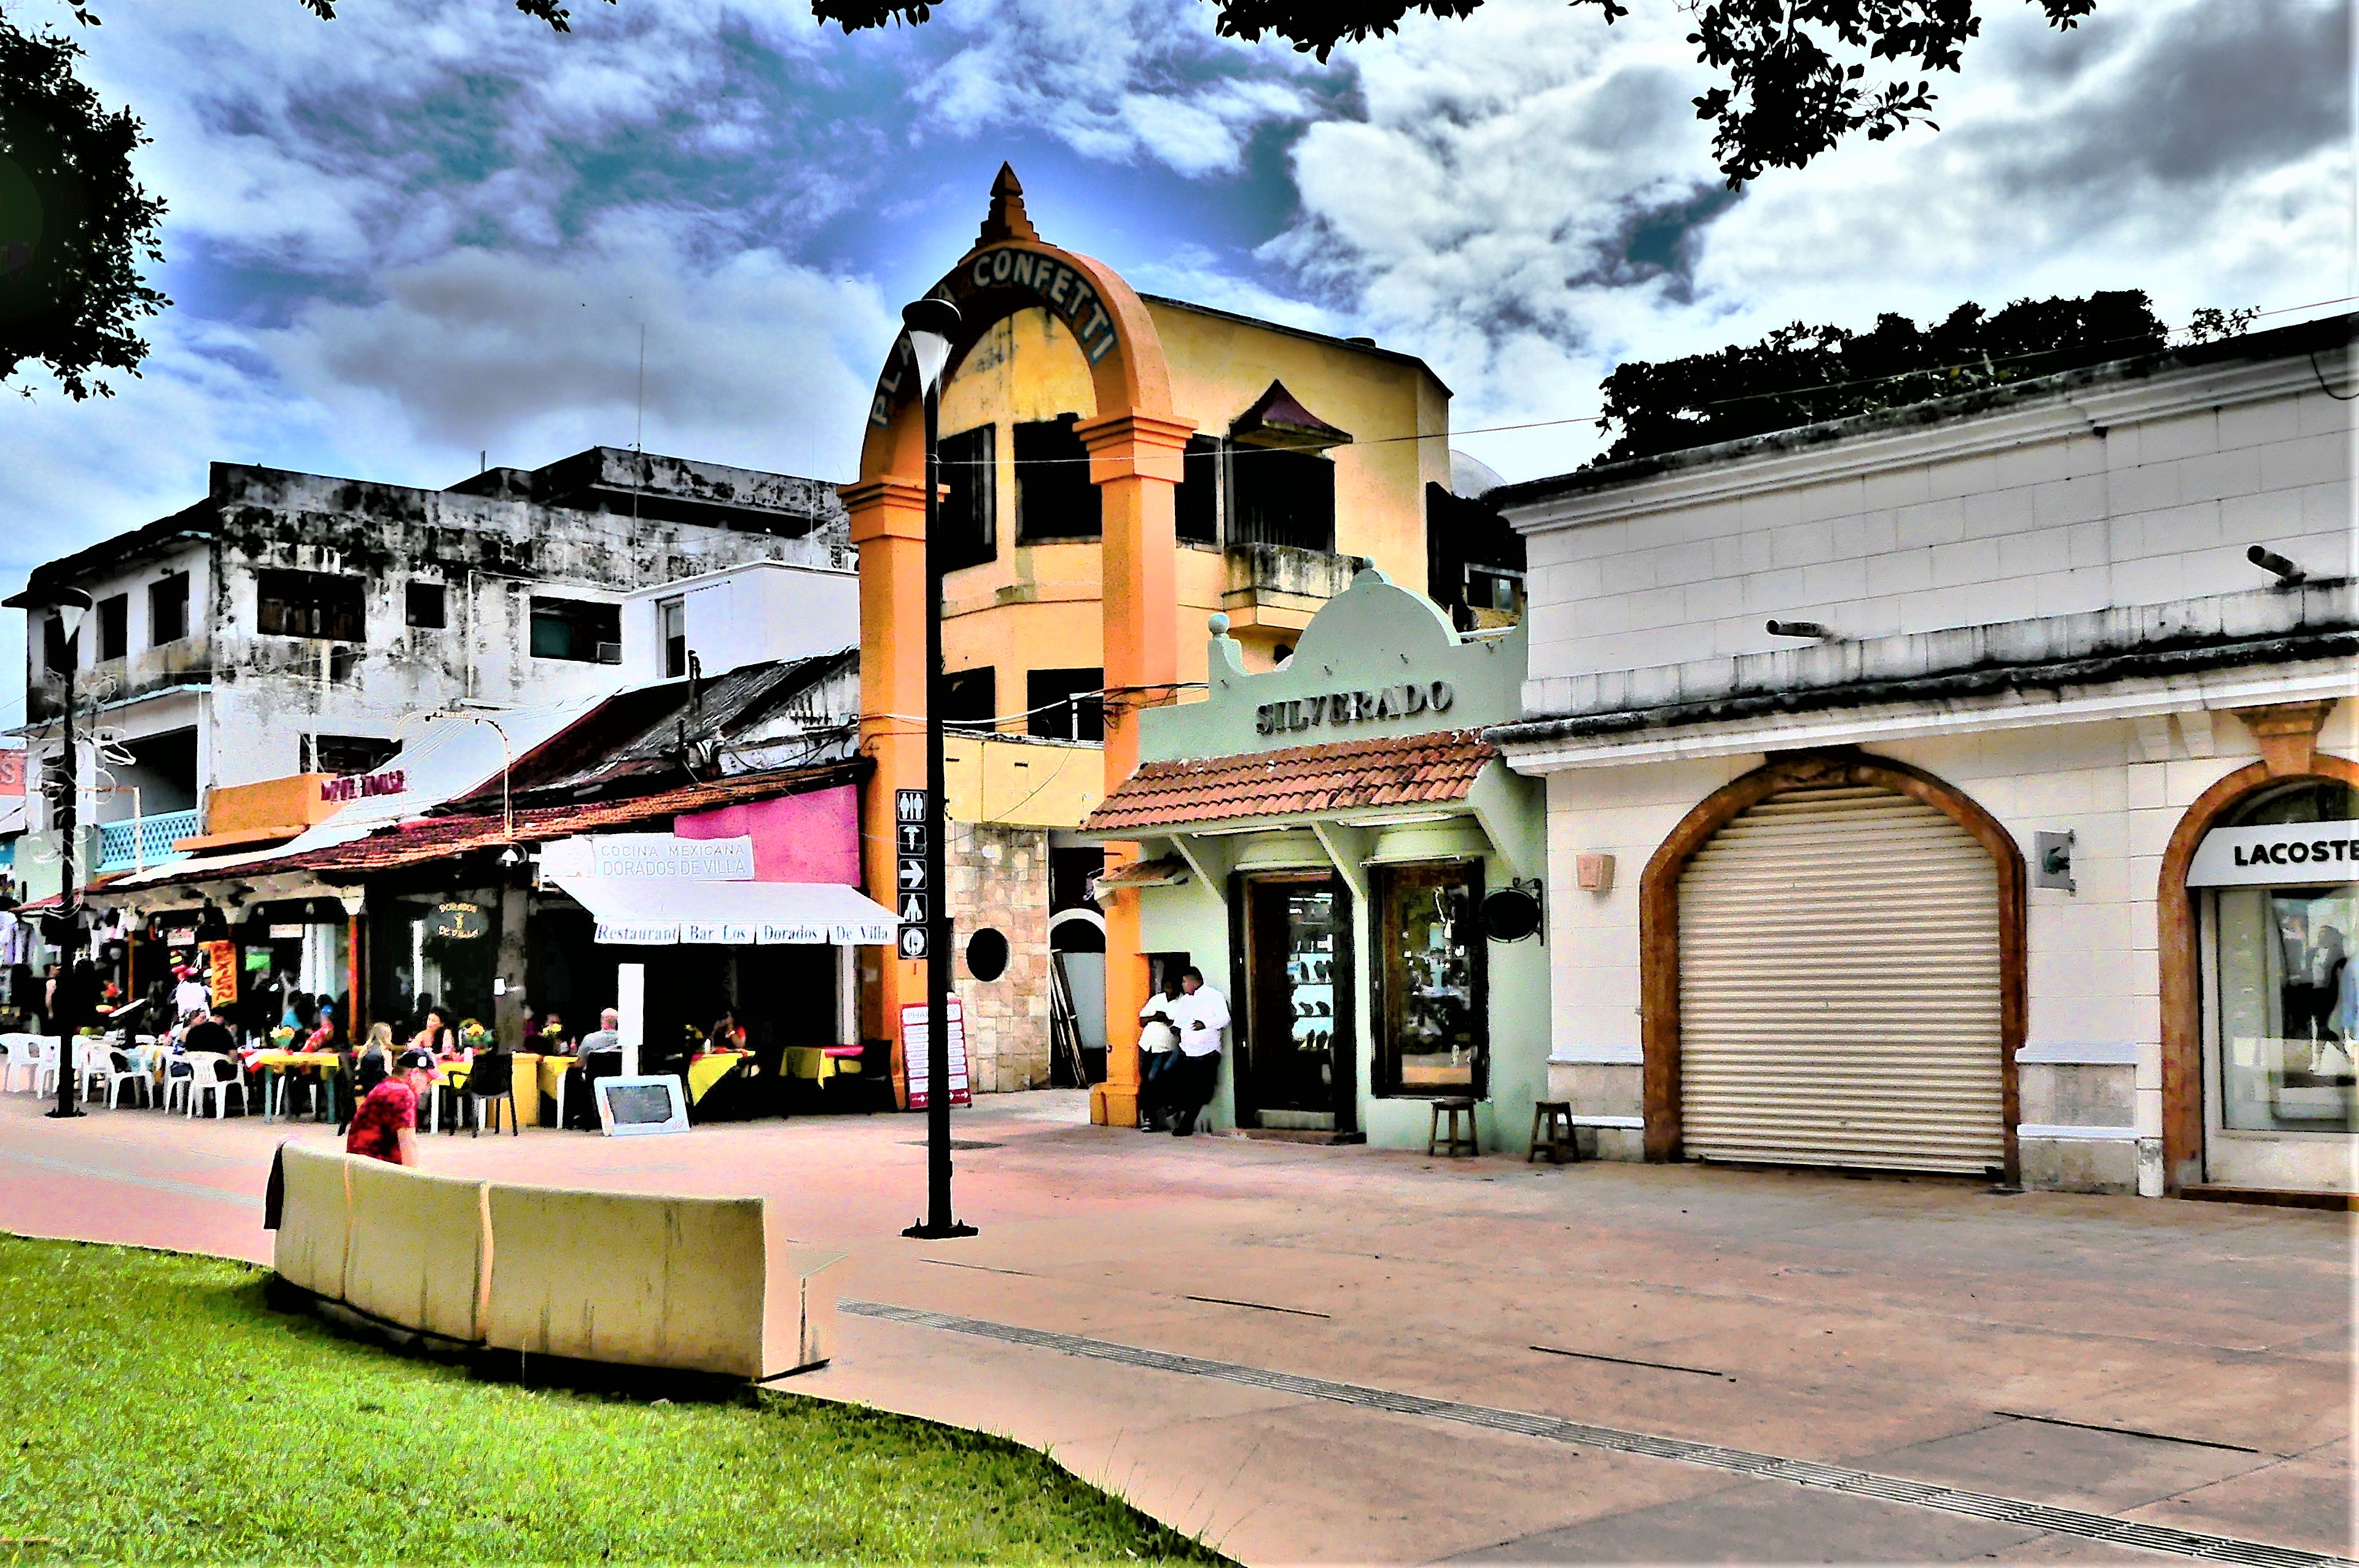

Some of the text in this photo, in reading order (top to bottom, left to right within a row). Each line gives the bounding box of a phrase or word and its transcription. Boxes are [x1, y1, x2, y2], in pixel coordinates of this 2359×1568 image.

[870, 248, 1119, 429] PLAA CONFETTI
[1256, 680, 1454, 736] SILVERADO
[601, 844, 745, 857] COCINA MEXICANA
[2234, 839, 2359, 866] LACOSTE
[603, 859, 746, 876] DORADOS DE VILLA
[597, 924, 888, 940] Restaurant Bar Los Dorados De Villa
